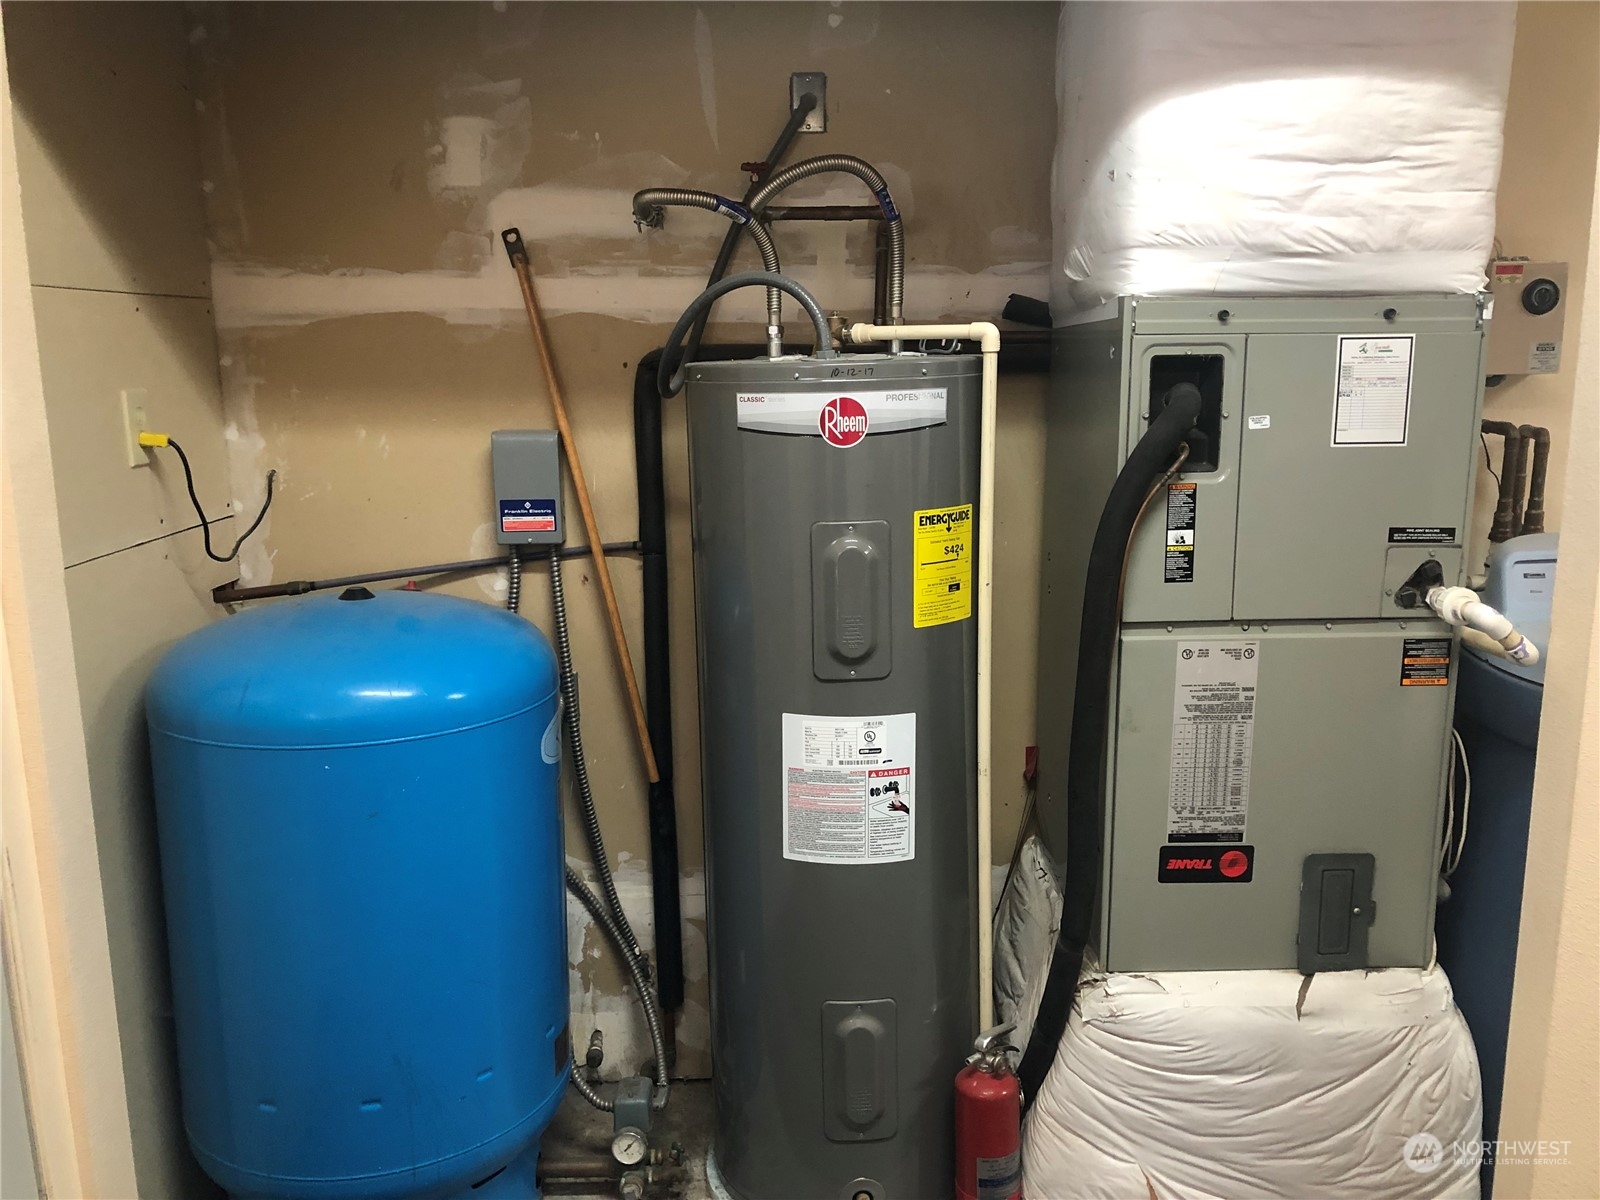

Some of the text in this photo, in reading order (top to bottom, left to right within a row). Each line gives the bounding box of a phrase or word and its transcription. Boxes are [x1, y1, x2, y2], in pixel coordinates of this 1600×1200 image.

[831, 367, 874, 378] 10-12-17
[825, 398, 866, 439] Rheem
[944, 544, 964, 555] $424
[878, 768, 908, 777] DANGER
[1166, 859, 1212, 870] TRANE
